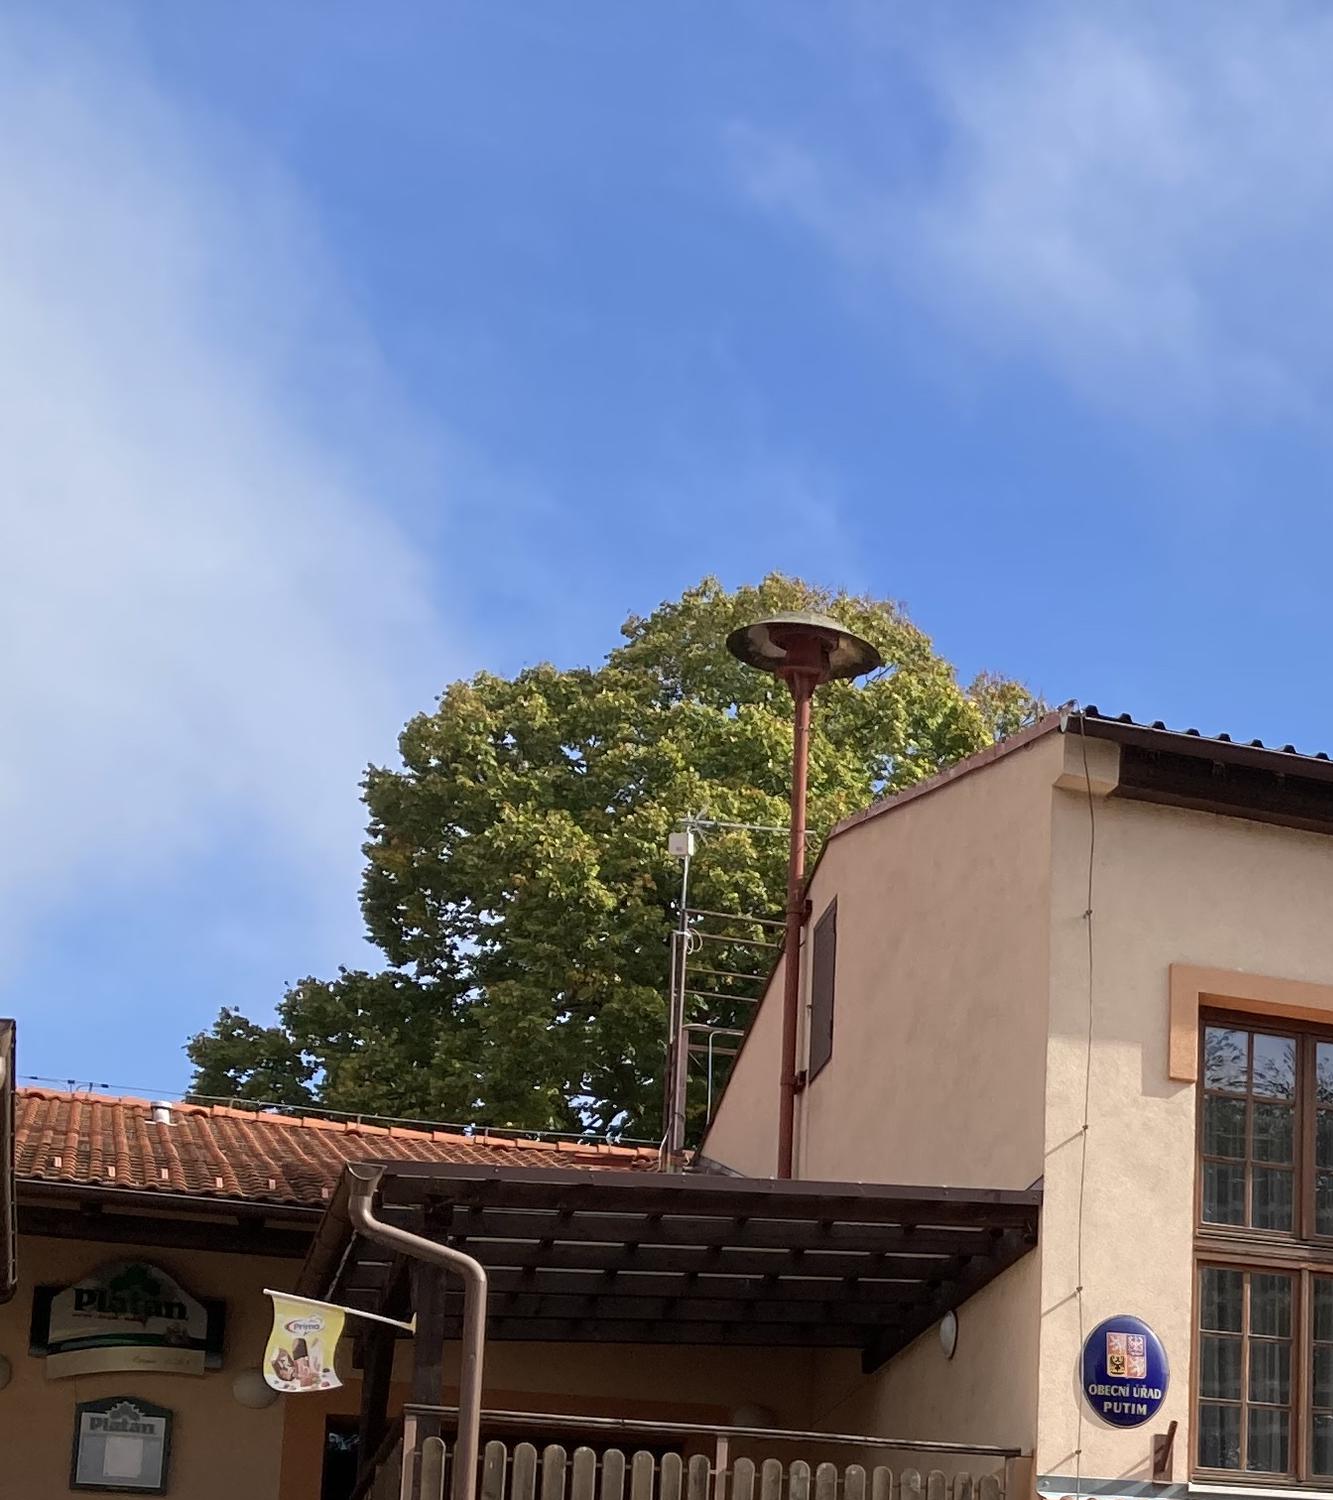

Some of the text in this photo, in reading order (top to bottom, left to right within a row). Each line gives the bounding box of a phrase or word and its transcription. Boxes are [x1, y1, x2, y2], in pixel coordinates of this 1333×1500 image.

[74, 1288, 188, 1321] Platan
[1088, 1383, 1162, 1400] OBECNÍ ÚŘAD
[1103, 1401, 1148, 1416] PUTIM
[89, 1416, 155, 1435] Platan
